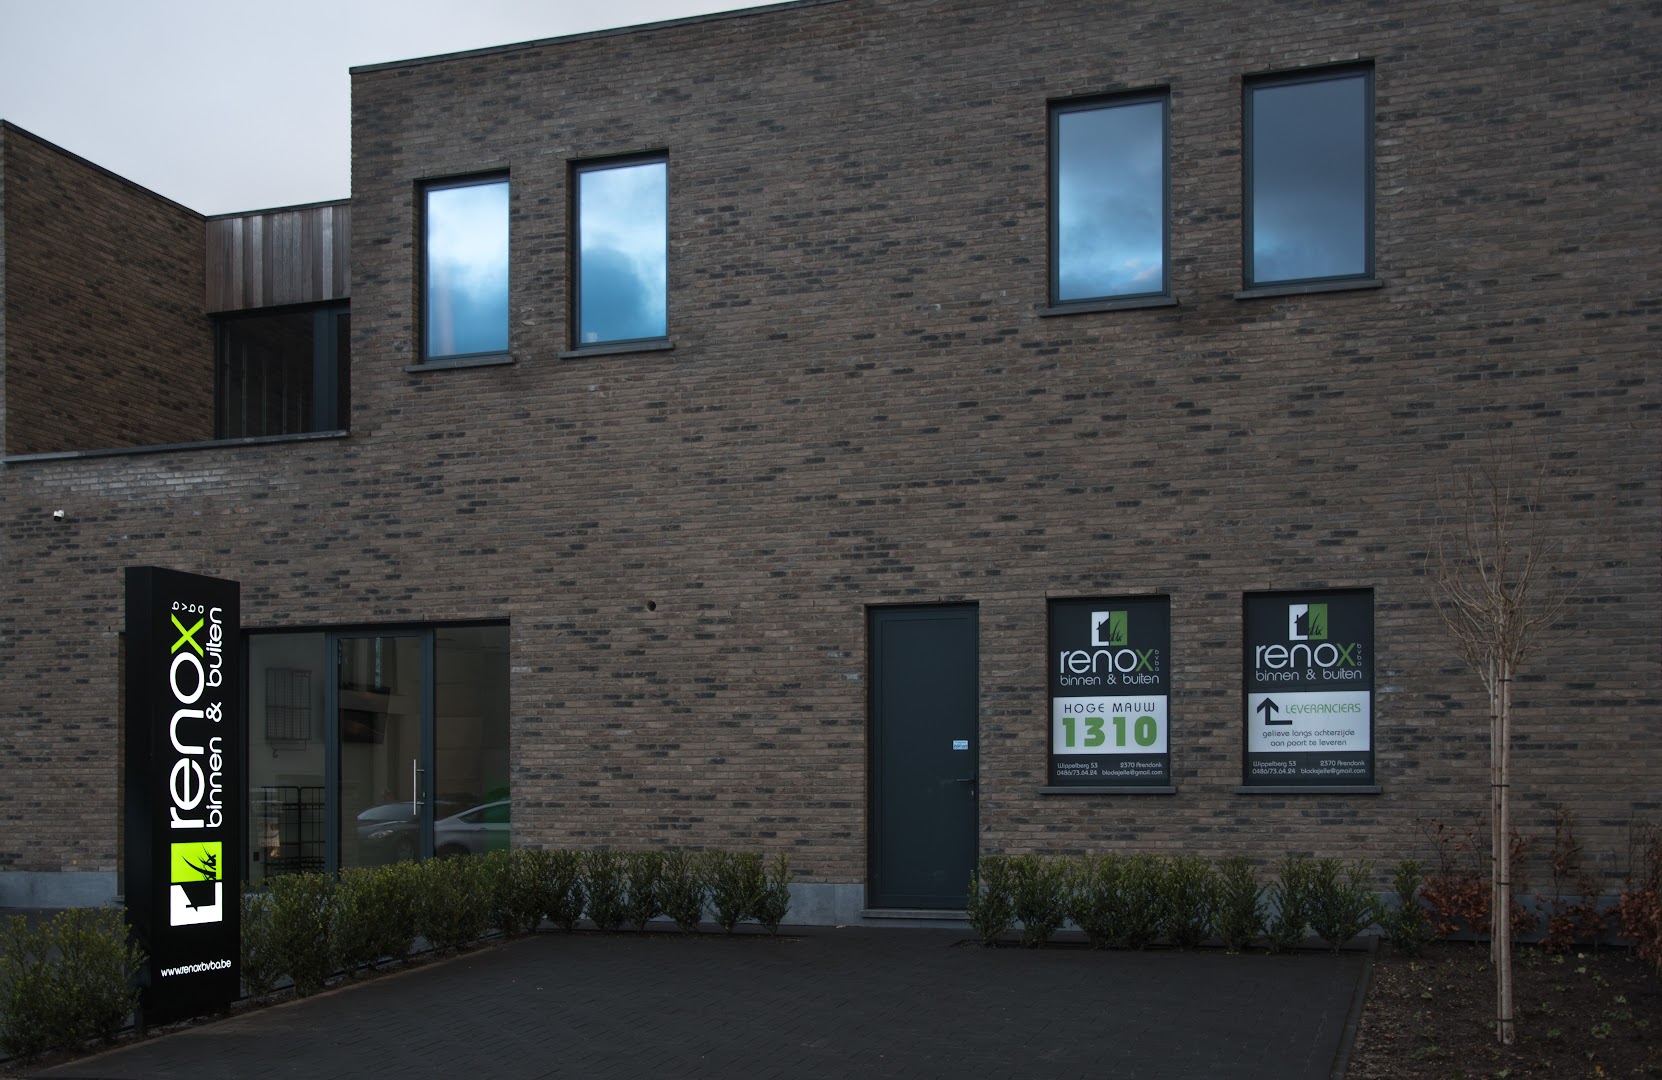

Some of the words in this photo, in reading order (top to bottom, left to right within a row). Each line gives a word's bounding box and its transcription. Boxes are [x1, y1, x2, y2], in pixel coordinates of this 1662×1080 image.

[206, 607, 222, 687] buiten
[1256, 643, 1356, 669] renox
[1060, 649, 1154, 674] renox
[1060, 675, 1101, 686] binnen
[1107, 674, 1117, 685] &
[1122, 673, 1159, 685] buiten
[1256, 670, 1299, 681] binnen
[1306, 669, 1316, 680] &
[1323, 668, 1362, 680] buiten
[206, 702, 222, 722] &
[1064, 703, 1104, 713] HOGE
[1112, 702, 1155, 713] MAUW
[1285, 703, 1361, 714] LEVERANCIERS
[170, 613, 205, 828] renox
[1062, 716, 1157, 747] 1310
[1262, 730, 1290, 739] gelieve
[1292, 729, 1312, 738] langs
[1314, 729, 1355, 738] achterzijde
[1286, 739, 1307, 748] poort
[1319, 738, 1347, 746] leveren
[206, 737, 222, 828] binnen
